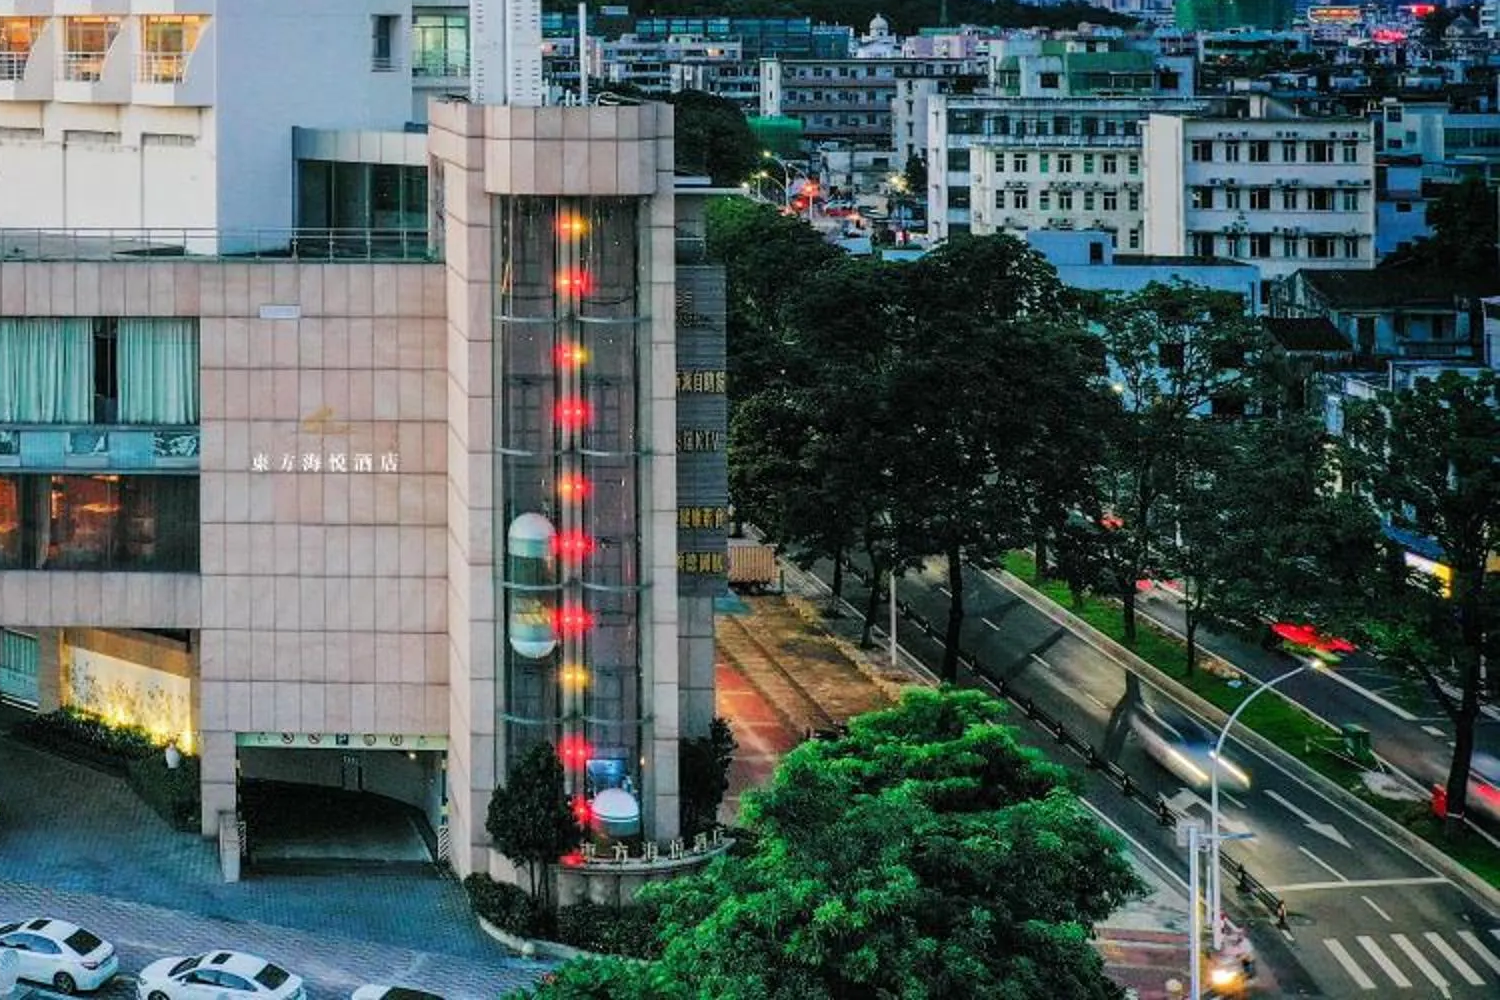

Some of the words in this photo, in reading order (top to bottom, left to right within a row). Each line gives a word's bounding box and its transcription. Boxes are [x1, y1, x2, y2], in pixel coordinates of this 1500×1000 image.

[252, 452, 399, 472] 東方海悦酒店
